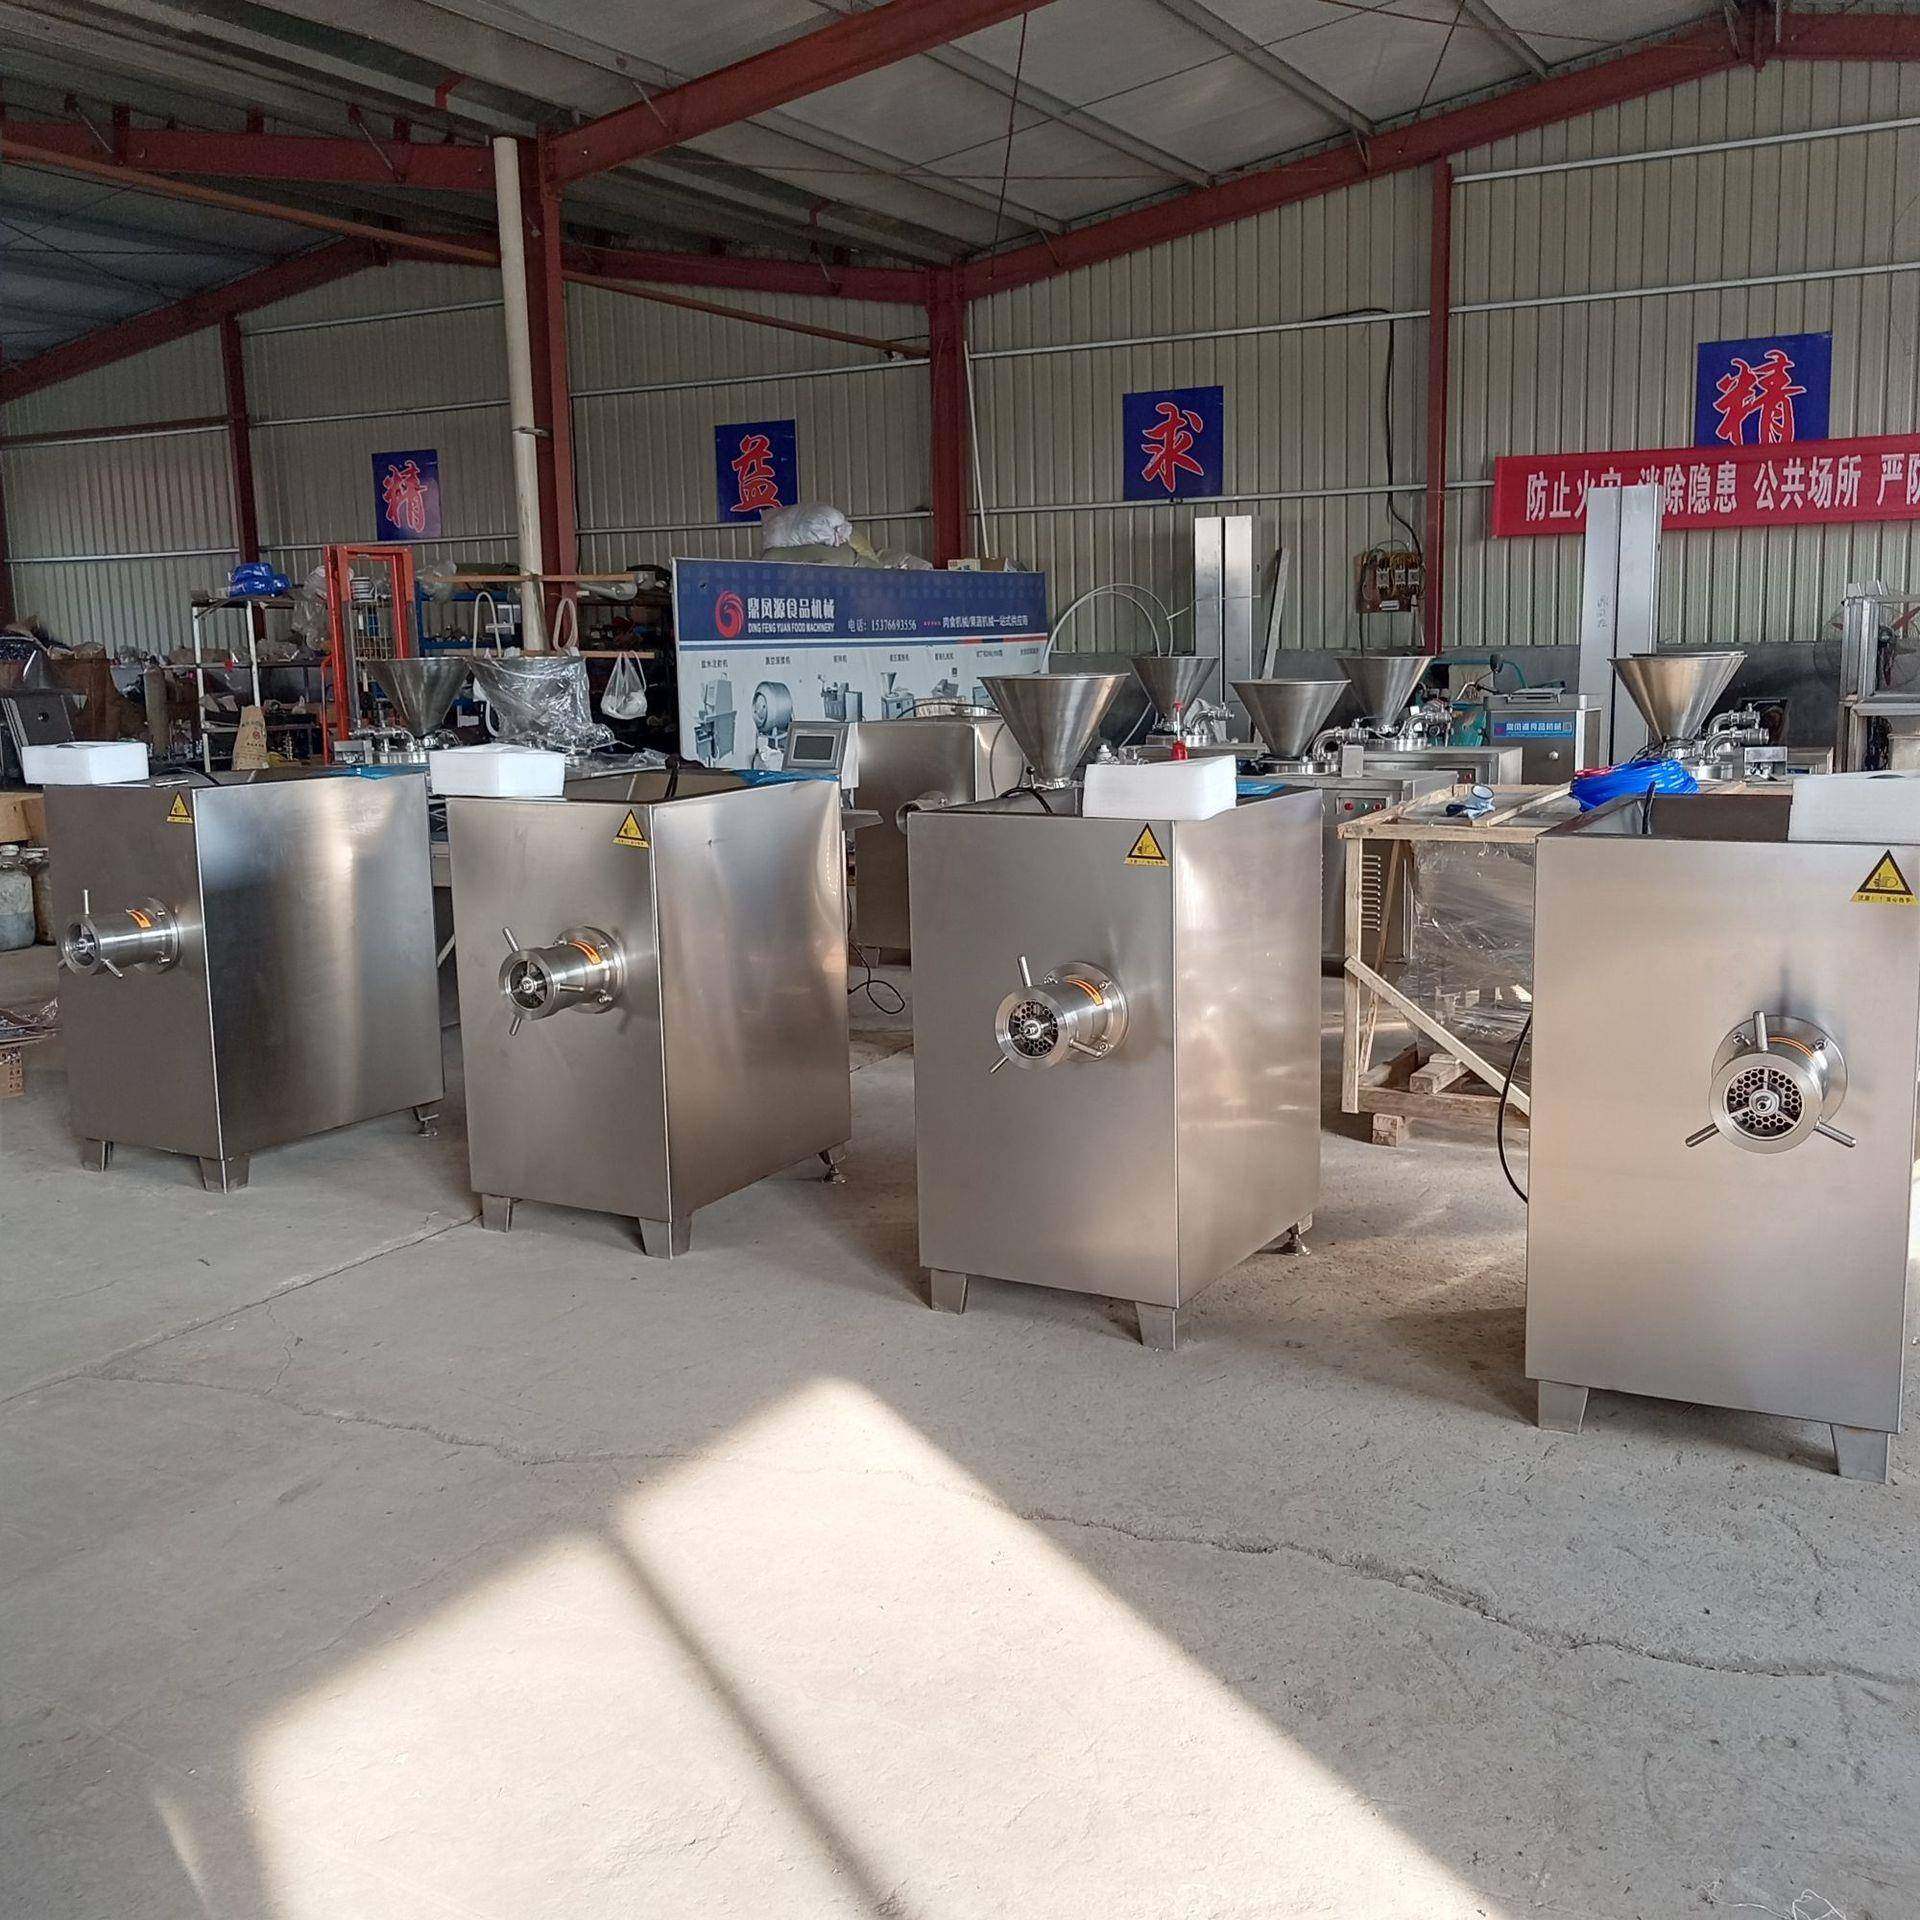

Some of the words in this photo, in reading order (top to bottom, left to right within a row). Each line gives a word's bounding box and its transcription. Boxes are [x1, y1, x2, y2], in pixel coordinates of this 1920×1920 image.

[1714, 348, 1806, 446] 精
[730, 433, 783, 513] 益
[1141, 401, 1204, 493] 求
[1753, 454, 1862, 511] 公共场所
[748, 622, 761, 633] DING
[762, 622, 776, 633] FENG
[777, 622, 791, 633] YUAN
[791, 622, 806, 633] FOOD
[807, 622, 835, 633] MACHINERY
